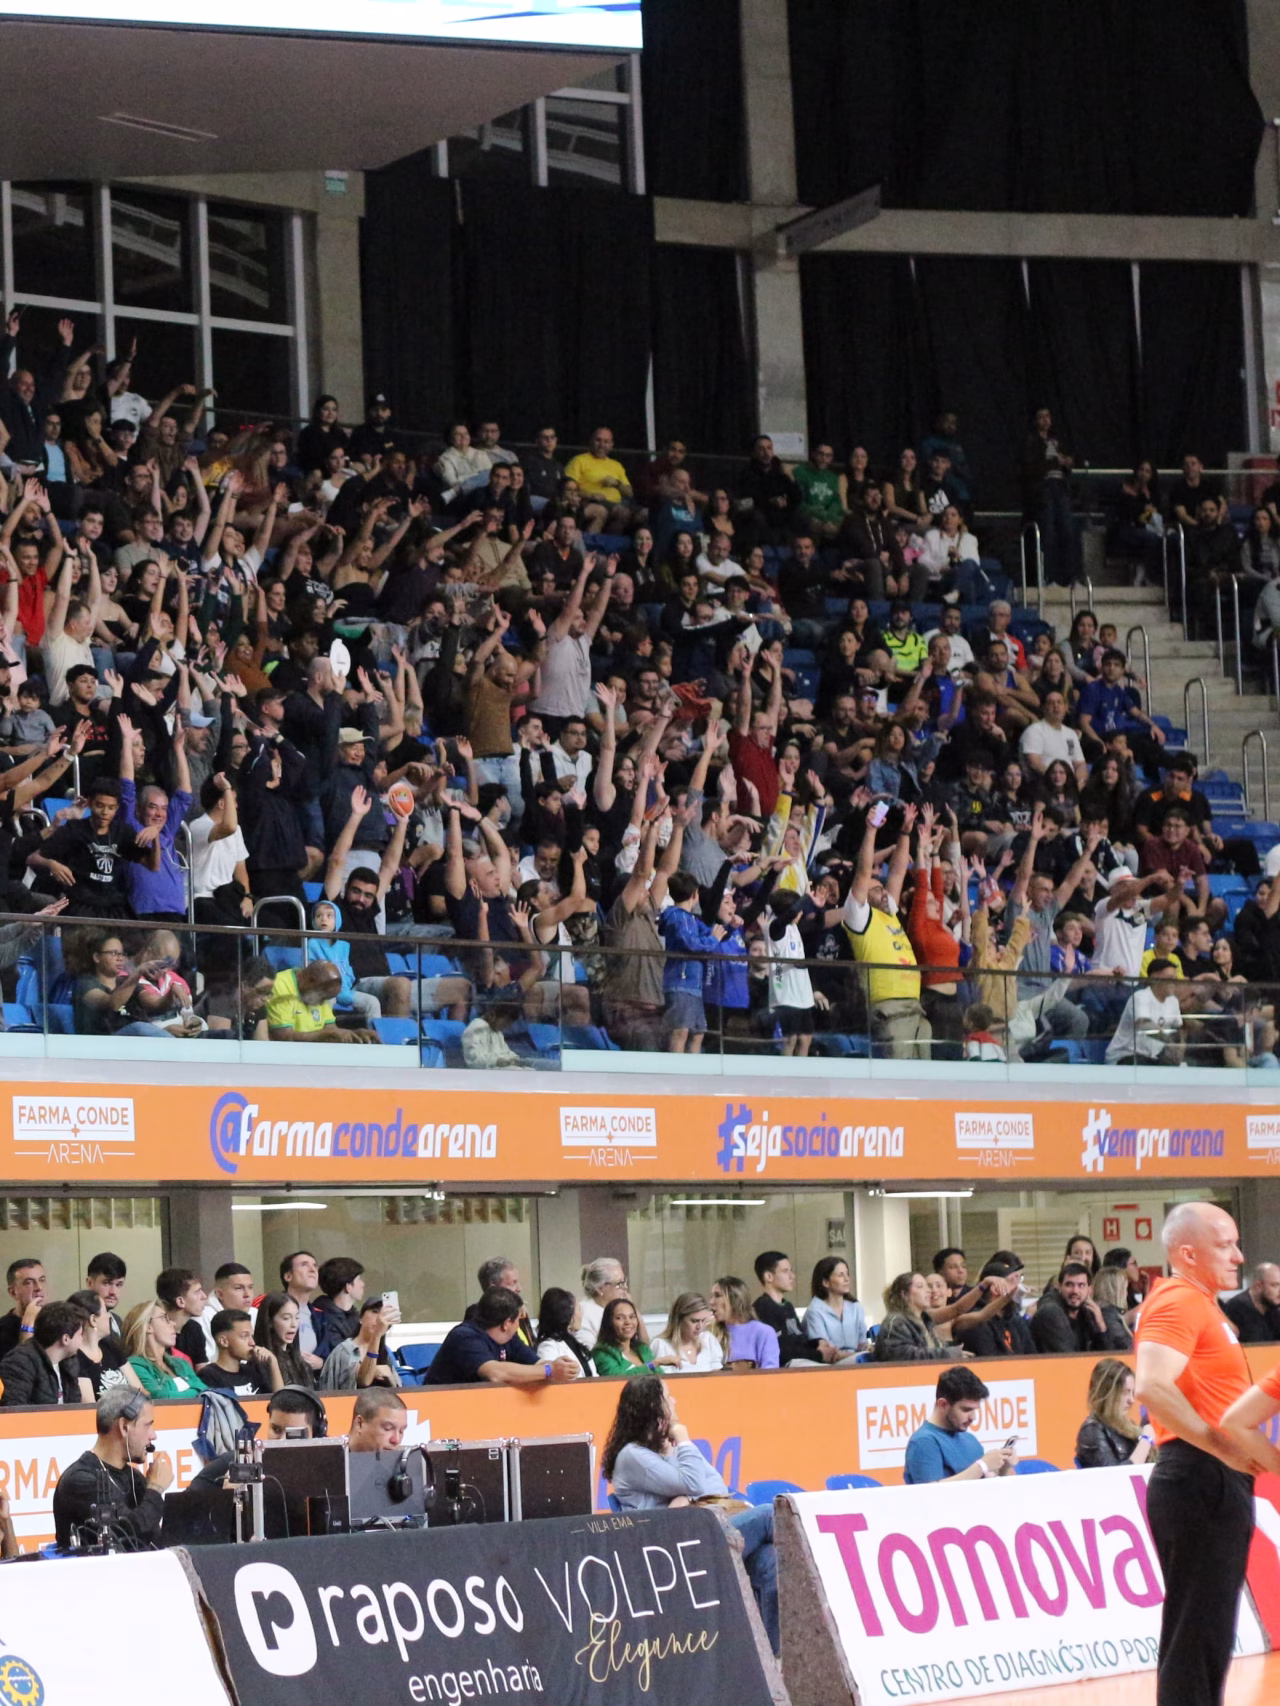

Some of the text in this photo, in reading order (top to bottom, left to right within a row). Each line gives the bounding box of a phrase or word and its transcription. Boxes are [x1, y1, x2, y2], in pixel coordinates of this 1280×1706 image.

[18, 1105, 130, 1126] FARMA CONDE
[209, 1092, 497, 1175] @farmacondearena
[563, 1115, 652, 1133] FARMA CONDE
[958, 1119, 1030, 1137] FARMA CONDE
[47, 1142, 104, 1164] ARENA
[588, 1147, 634, 1167] ARENA
[717, 1103, 905, 1173] #sejasocioarena
[1081, 1108, 1225, 1173] #vempraarena
[978, 1149, 1016, 1168] ARENA
[865, 1402, 927, 1440] FARM
[586, 1516, 635, 1534] VILA EMA
[534, 1539, 721, 1634] VOLPE
[317, 1575, 524, 1663] raposo
[575, 1612, 719, 1692] Elegance
[408, 1657, 544, 1706] engenharia
[880, 1661, 963, 1698] CENTRO
[964, 1655, 991, 1686] DE
